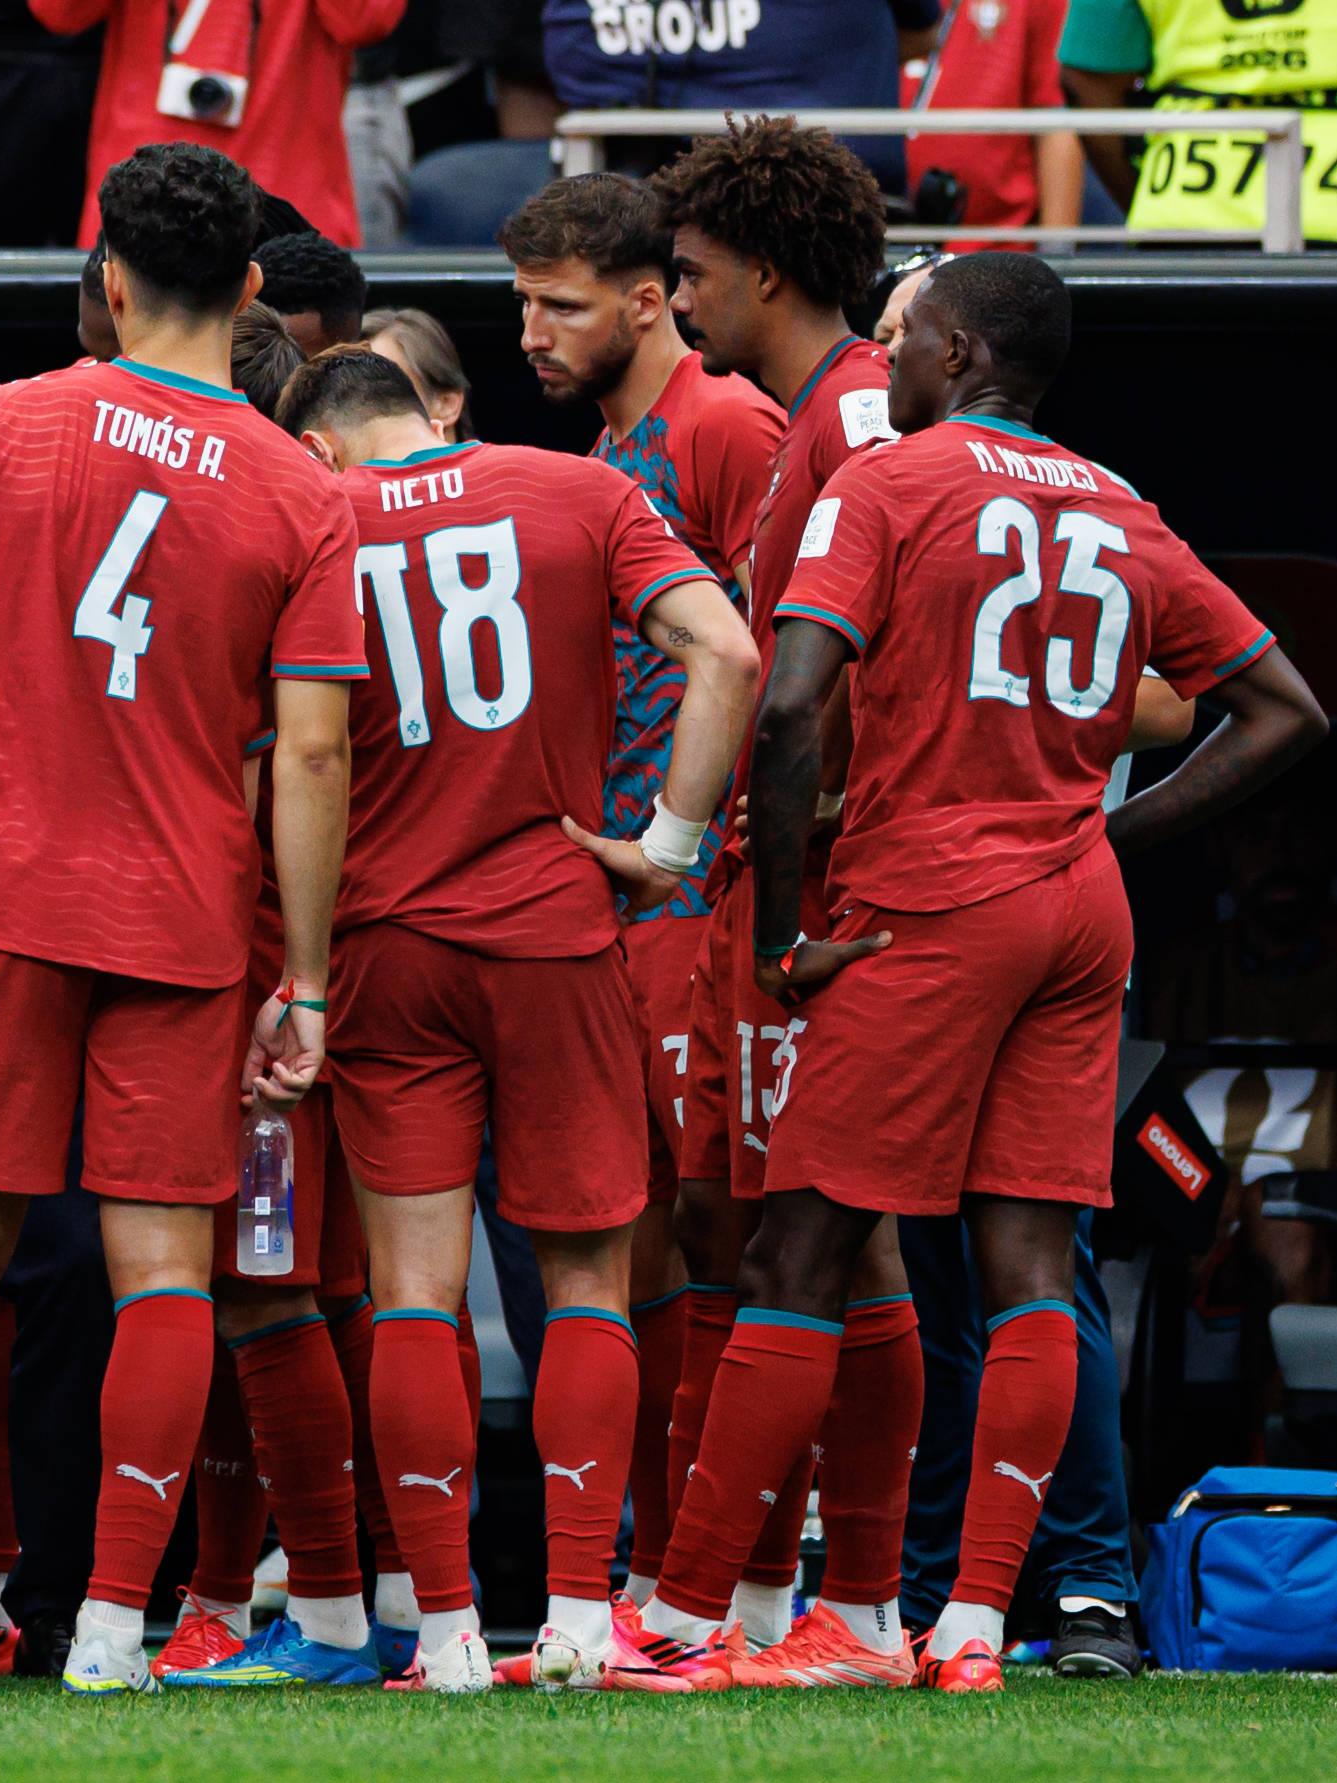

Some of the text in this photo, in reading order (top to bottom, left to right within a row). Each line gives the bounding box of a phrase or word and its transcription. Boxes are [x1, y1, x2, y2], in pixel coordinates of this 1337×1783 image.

[591, 0, 761, 55] GROUP
[93, 400, 226, 481] TOMÁS A.
[379, 468, 464, 512] NETO
[73, 489, 169, 701] 4
[358, 516, 532, 749] 18
[968, 496, 1130, 719] 25
[1148, 1126, 1203, 1190] Lenovo
